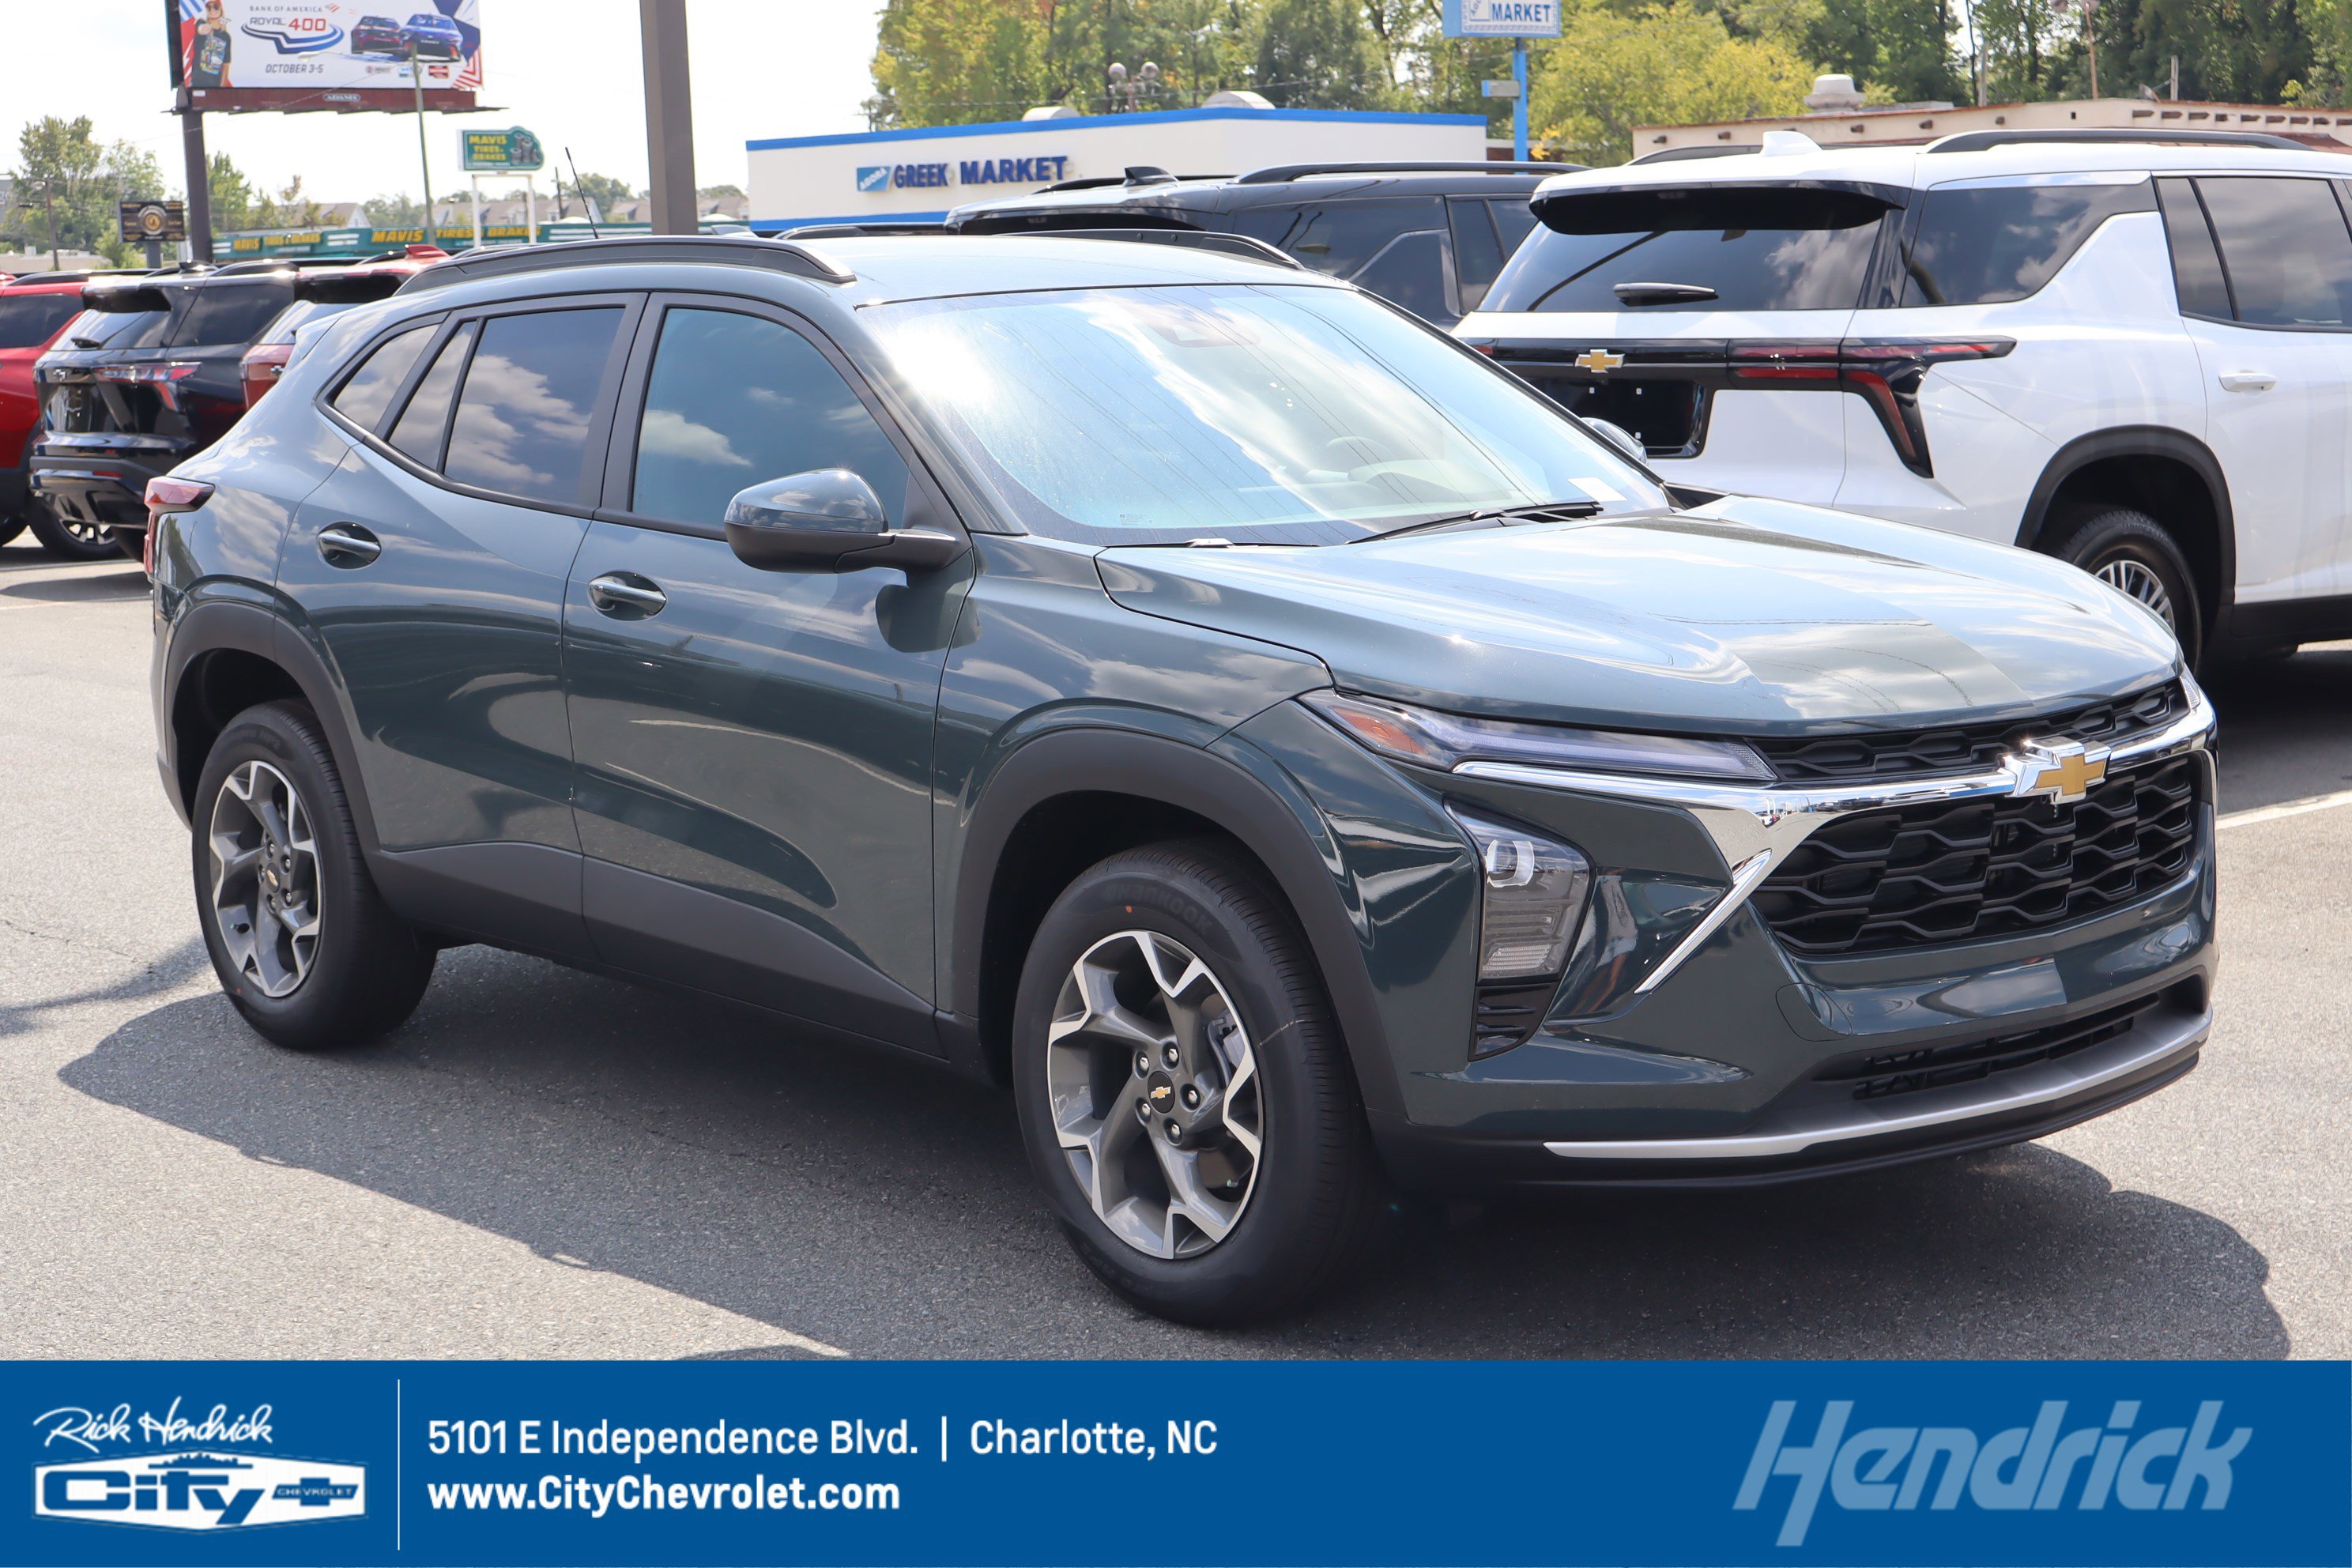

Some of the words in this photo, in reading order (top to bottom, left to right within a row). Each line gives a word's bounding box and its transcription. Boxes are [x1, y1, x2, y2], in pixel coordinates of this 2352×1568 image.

[1492, 3, 1551, 22] MARKET
[288, 17, 326, 31] 400
[266, 64, 307, 74] OCTOBER
[309, 65, 324, 74] 3-5
[469, 135, 507, 145] MAVIS
[860, 168, 888, 190] AGORA
[895, 164, 948, 188] GREEK
[960, 156, 1069, 185] MARKET
[371, 228, 424, 243] MAVIS
[234, 238, 260, 251] MAVIS
